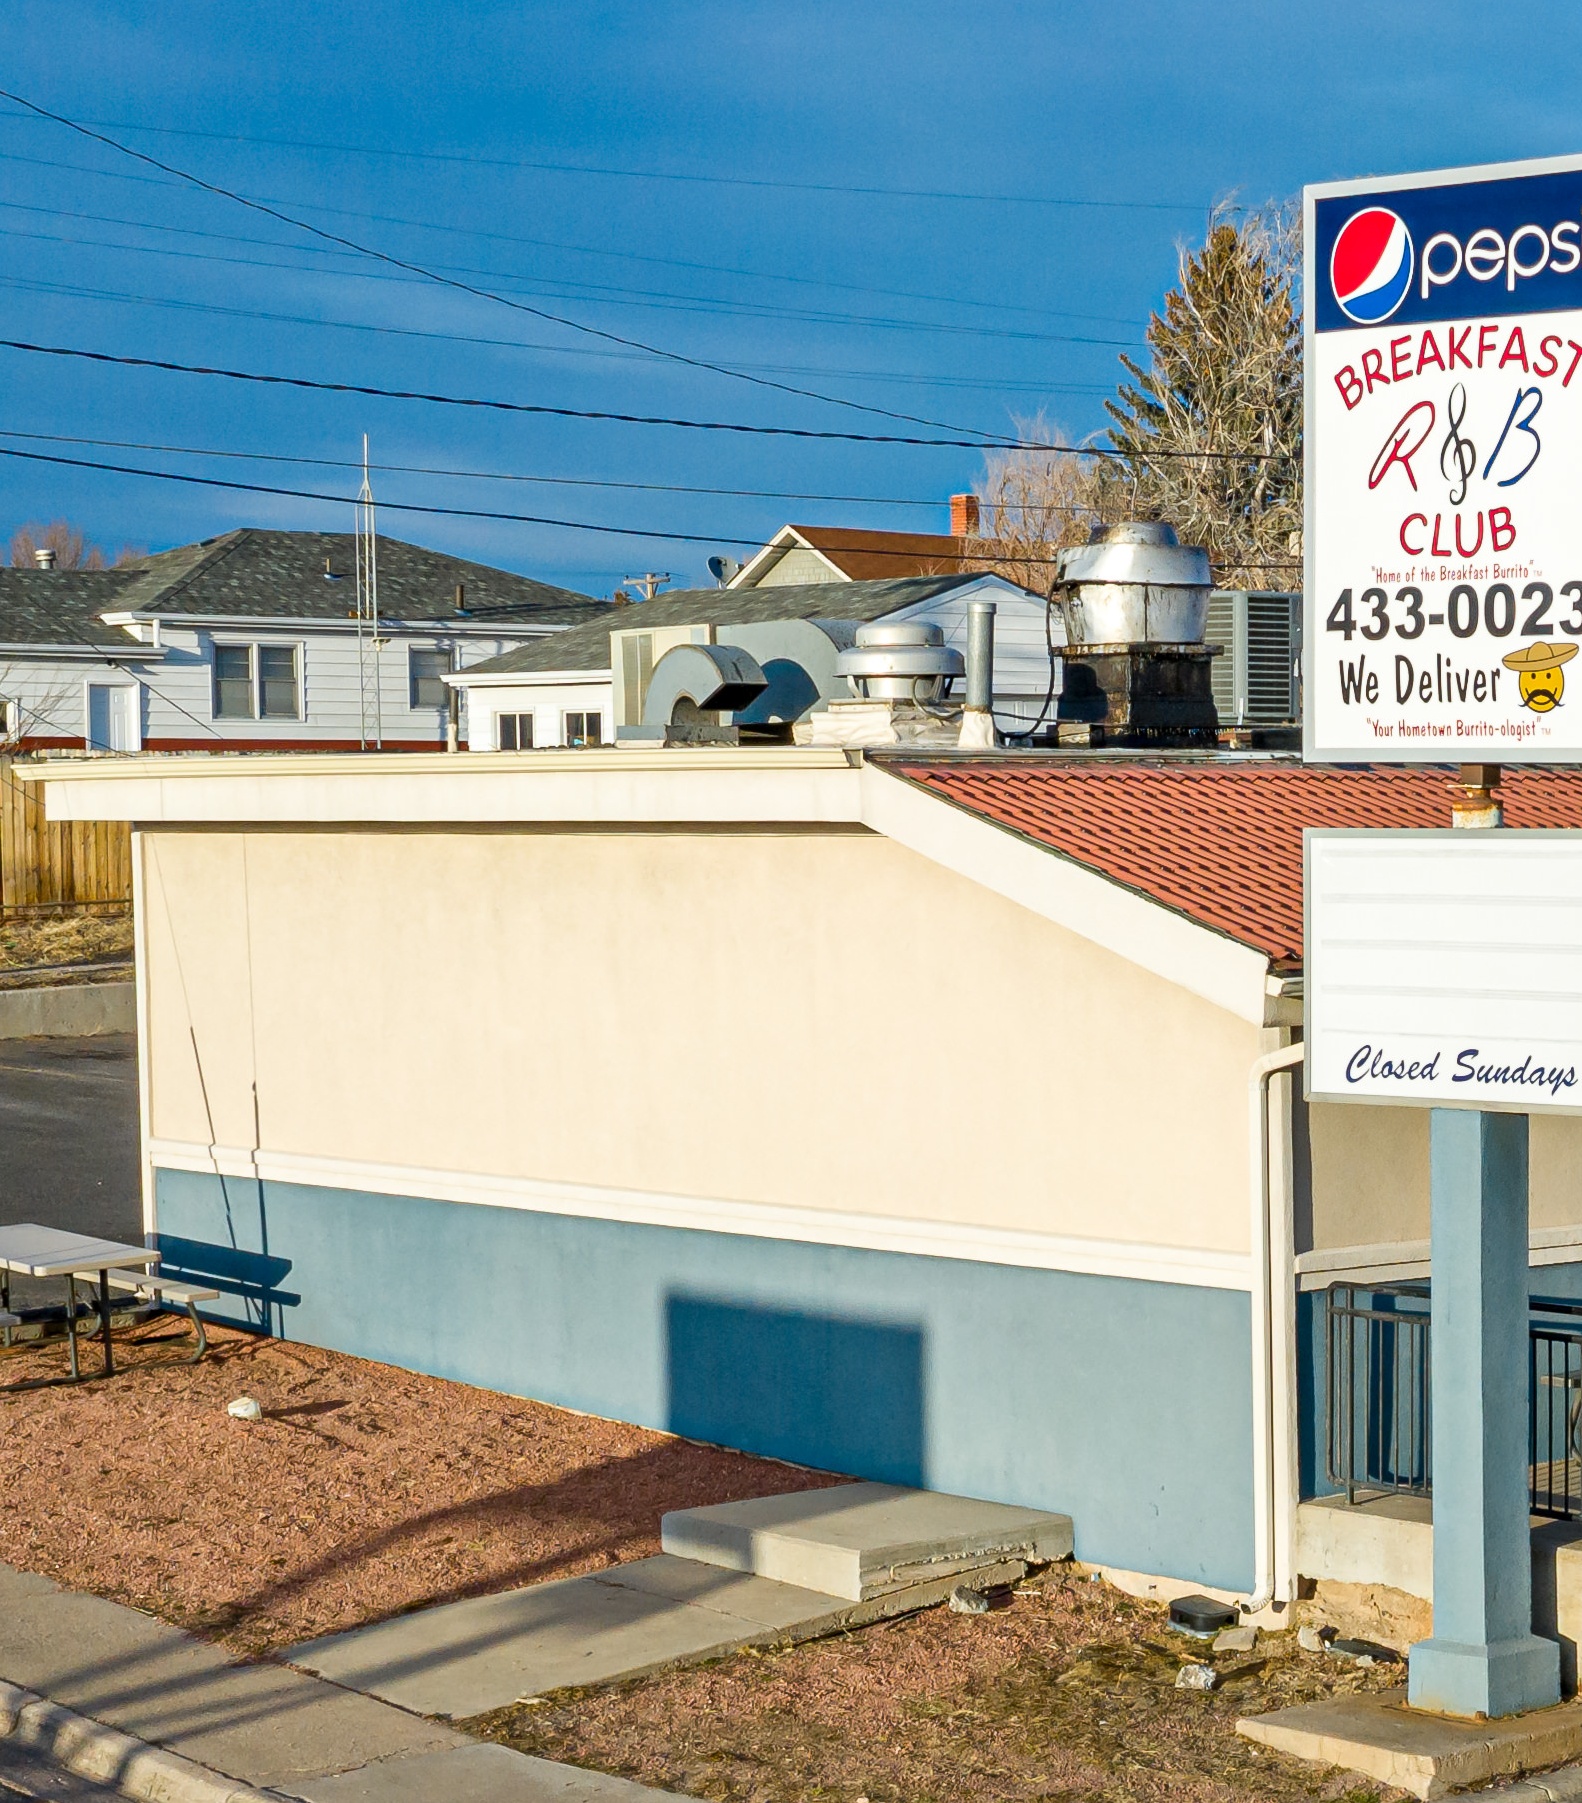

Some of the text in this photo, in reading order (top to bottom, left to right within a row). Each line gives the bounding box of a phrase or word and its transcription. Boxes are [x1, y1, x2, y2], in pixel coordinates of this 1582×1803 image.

[1400, 506, 1517, 558] CLUB
[1405, 567, 1416, 582] of
[1420, 566, 1436, 582] the
[1440, 564, 1489, 581] Breakfast
[1339, 653, 1500, 705] We Deliver
[1398, 719, 1452, 737] Hometown
[1345, 1045, 1578, 1095] Closed Sundays
